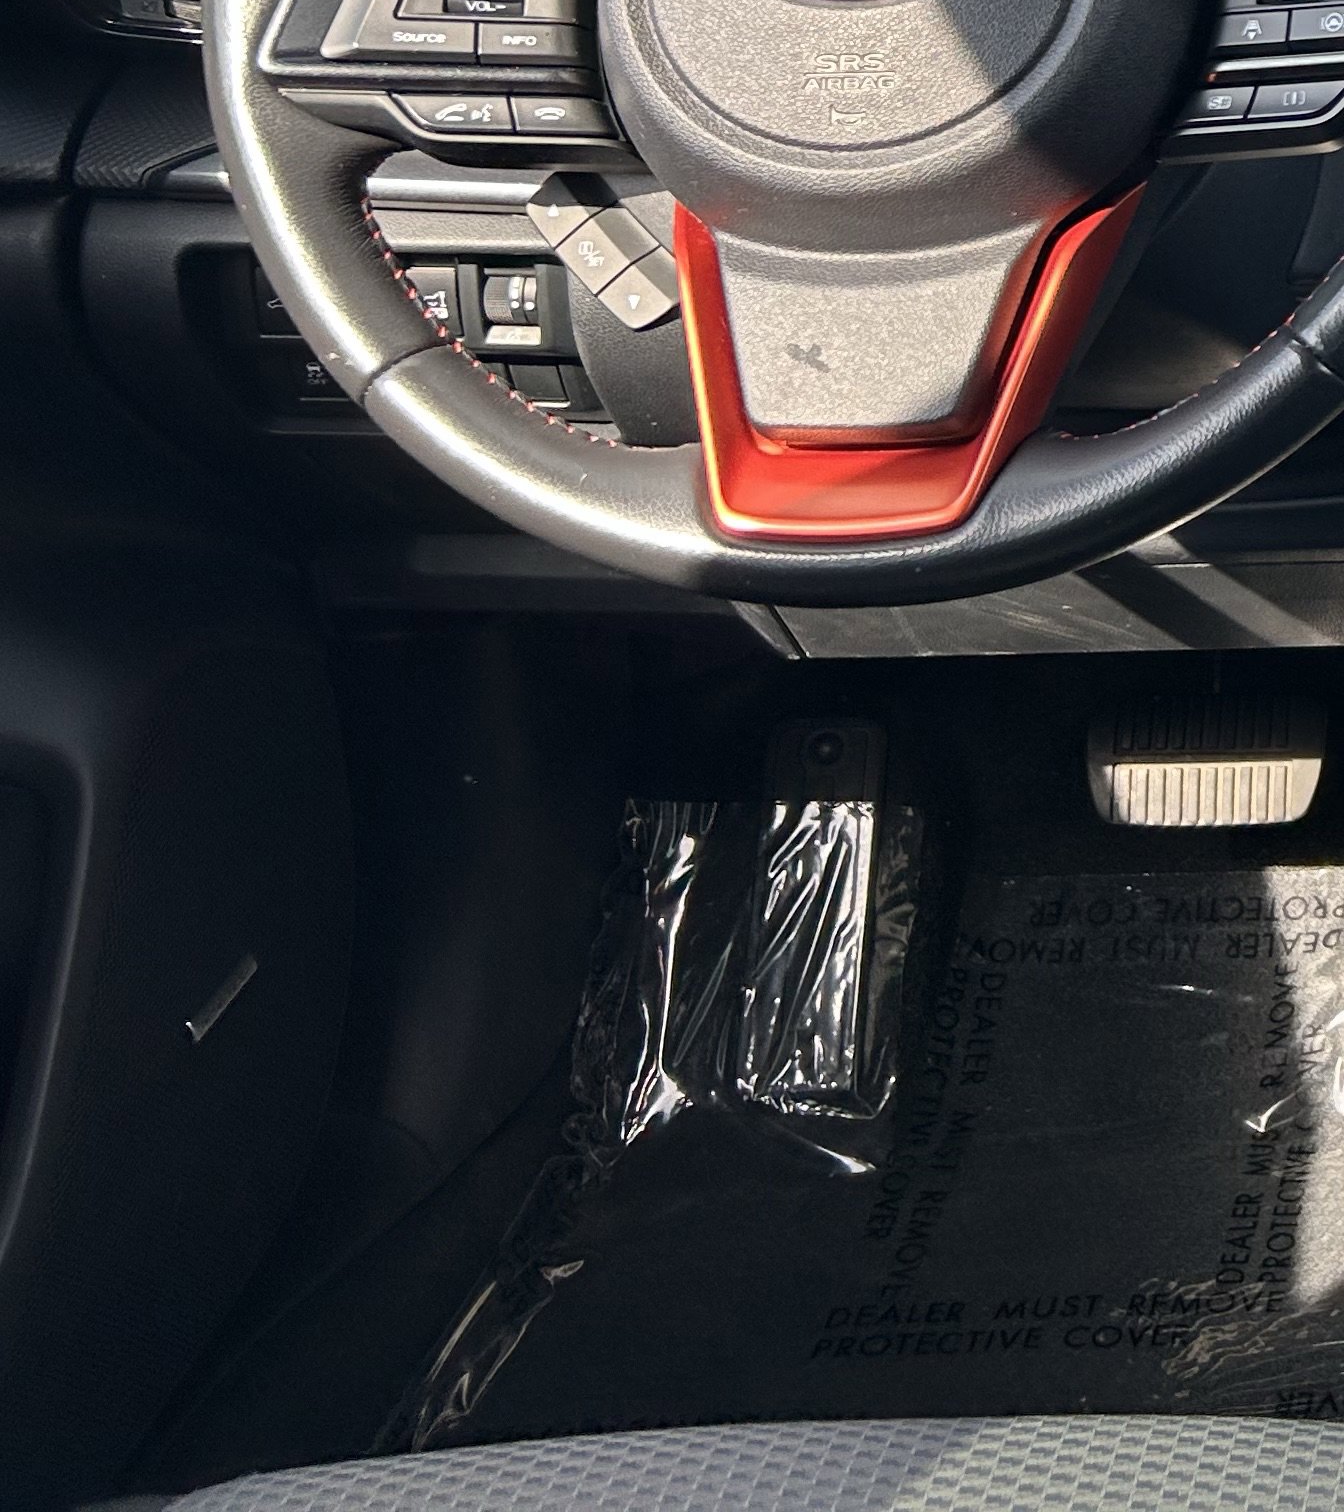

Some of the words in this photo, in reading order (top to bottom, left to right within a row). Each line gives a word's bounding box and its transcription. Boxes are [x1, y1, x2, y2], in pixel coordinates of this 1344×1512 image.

[502, 35, 538, 47] INFO
[814, 53, 886, 70] SRS
[803, 75, 897, 90] AIRBAG
[995, 1293, 1100, 1322] MUST
